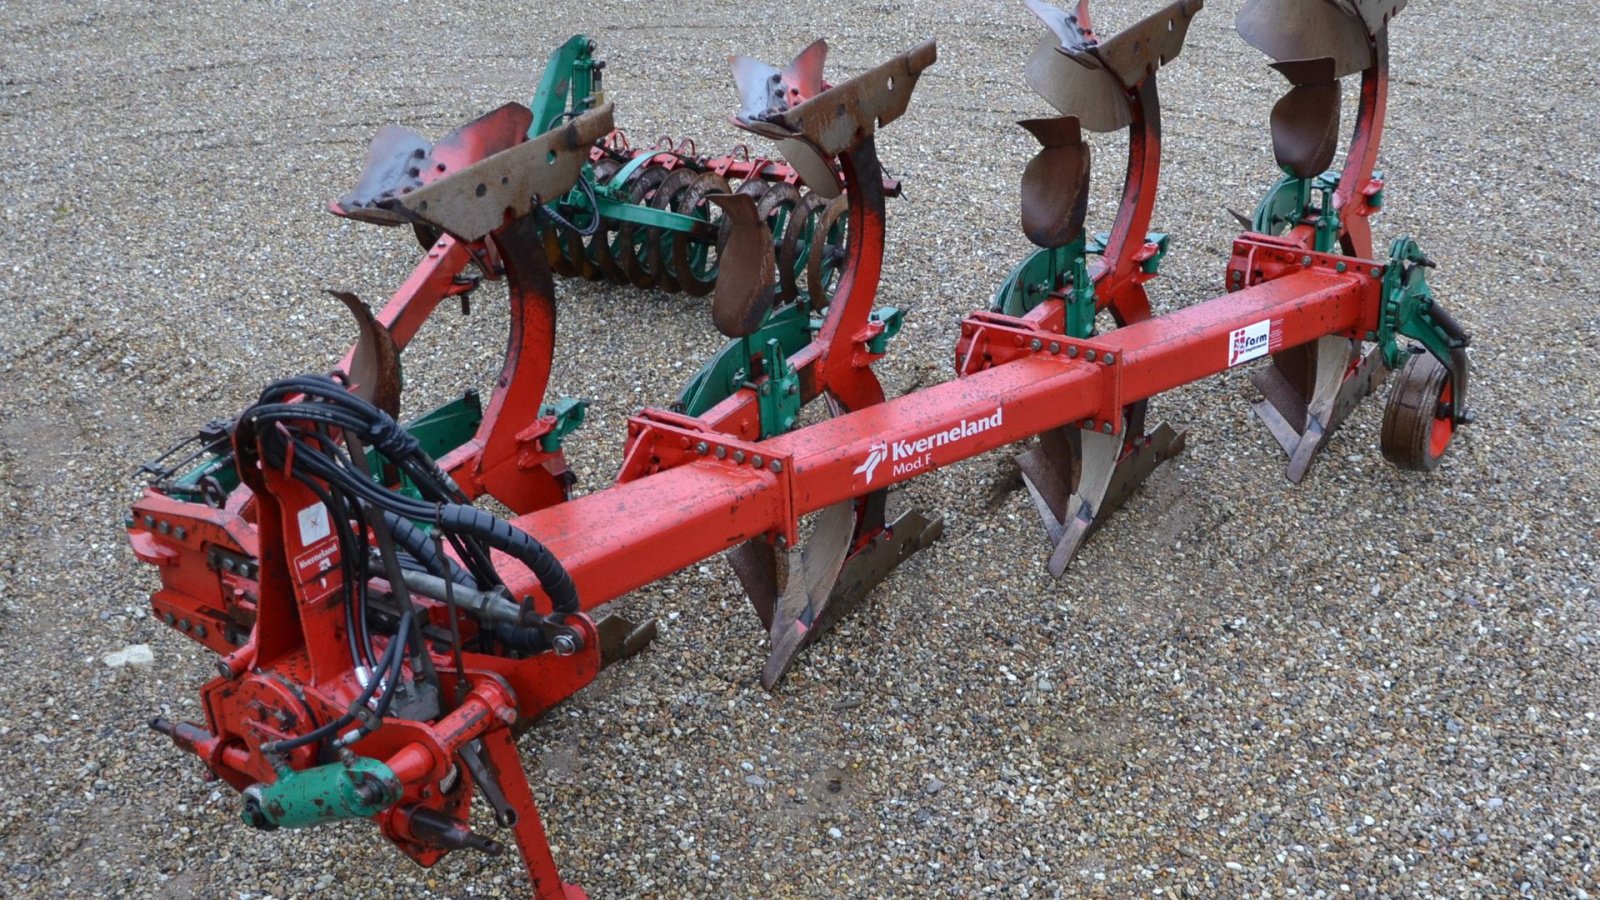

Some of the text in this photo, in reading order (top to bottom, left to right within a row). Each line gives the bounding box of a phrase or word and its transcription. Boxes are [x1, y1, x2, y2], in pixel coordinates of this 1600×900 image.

[1246, 334, 1267, 347] farm
[892, 407, 1003, 461] Kverneland
[893, 453, 932, 476] Mod. F
[299, 543, 338, 570] Kverneland
